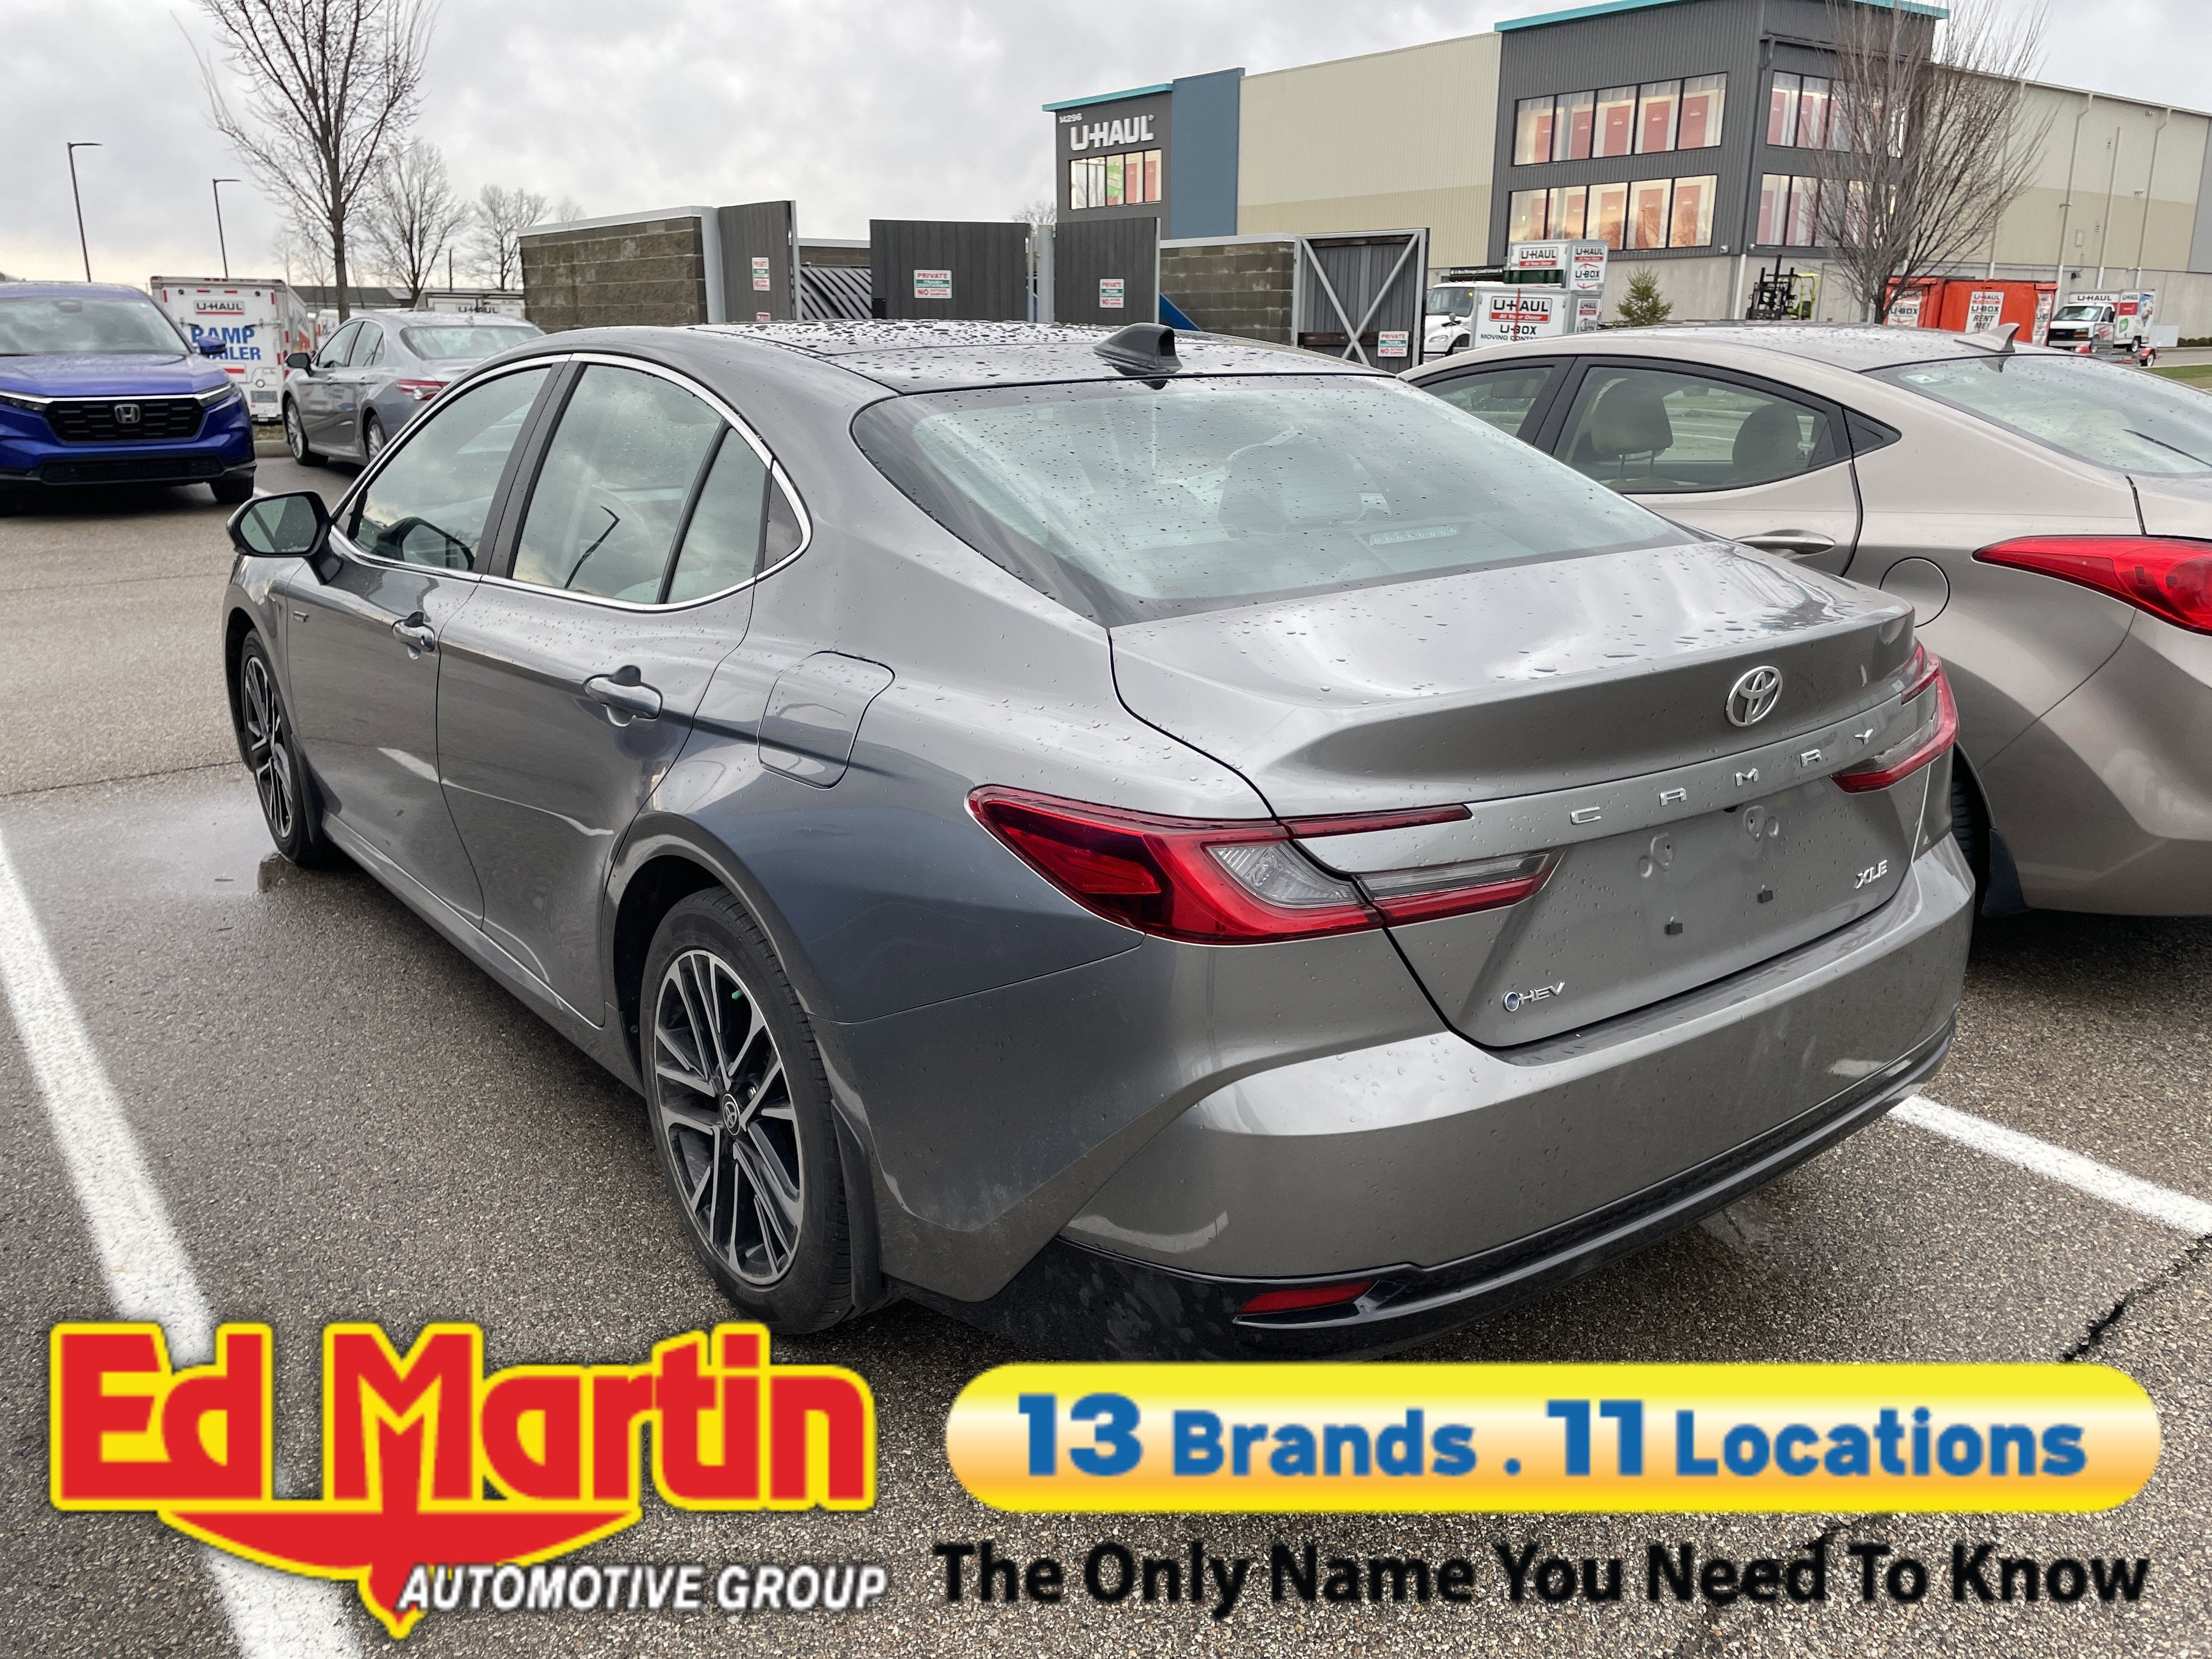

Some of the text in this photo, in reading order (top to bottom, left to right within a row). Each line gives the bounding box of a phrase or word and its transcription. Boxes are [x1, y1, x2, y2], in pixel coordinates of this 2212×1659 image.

[1070, 115, 1155, 151] U-HAUL
[1521, 250, 1556, 259] U-HAUL
[1570, 729, 1874, 825] CAMRY
[1854, 859, 1888, 889] XLE
